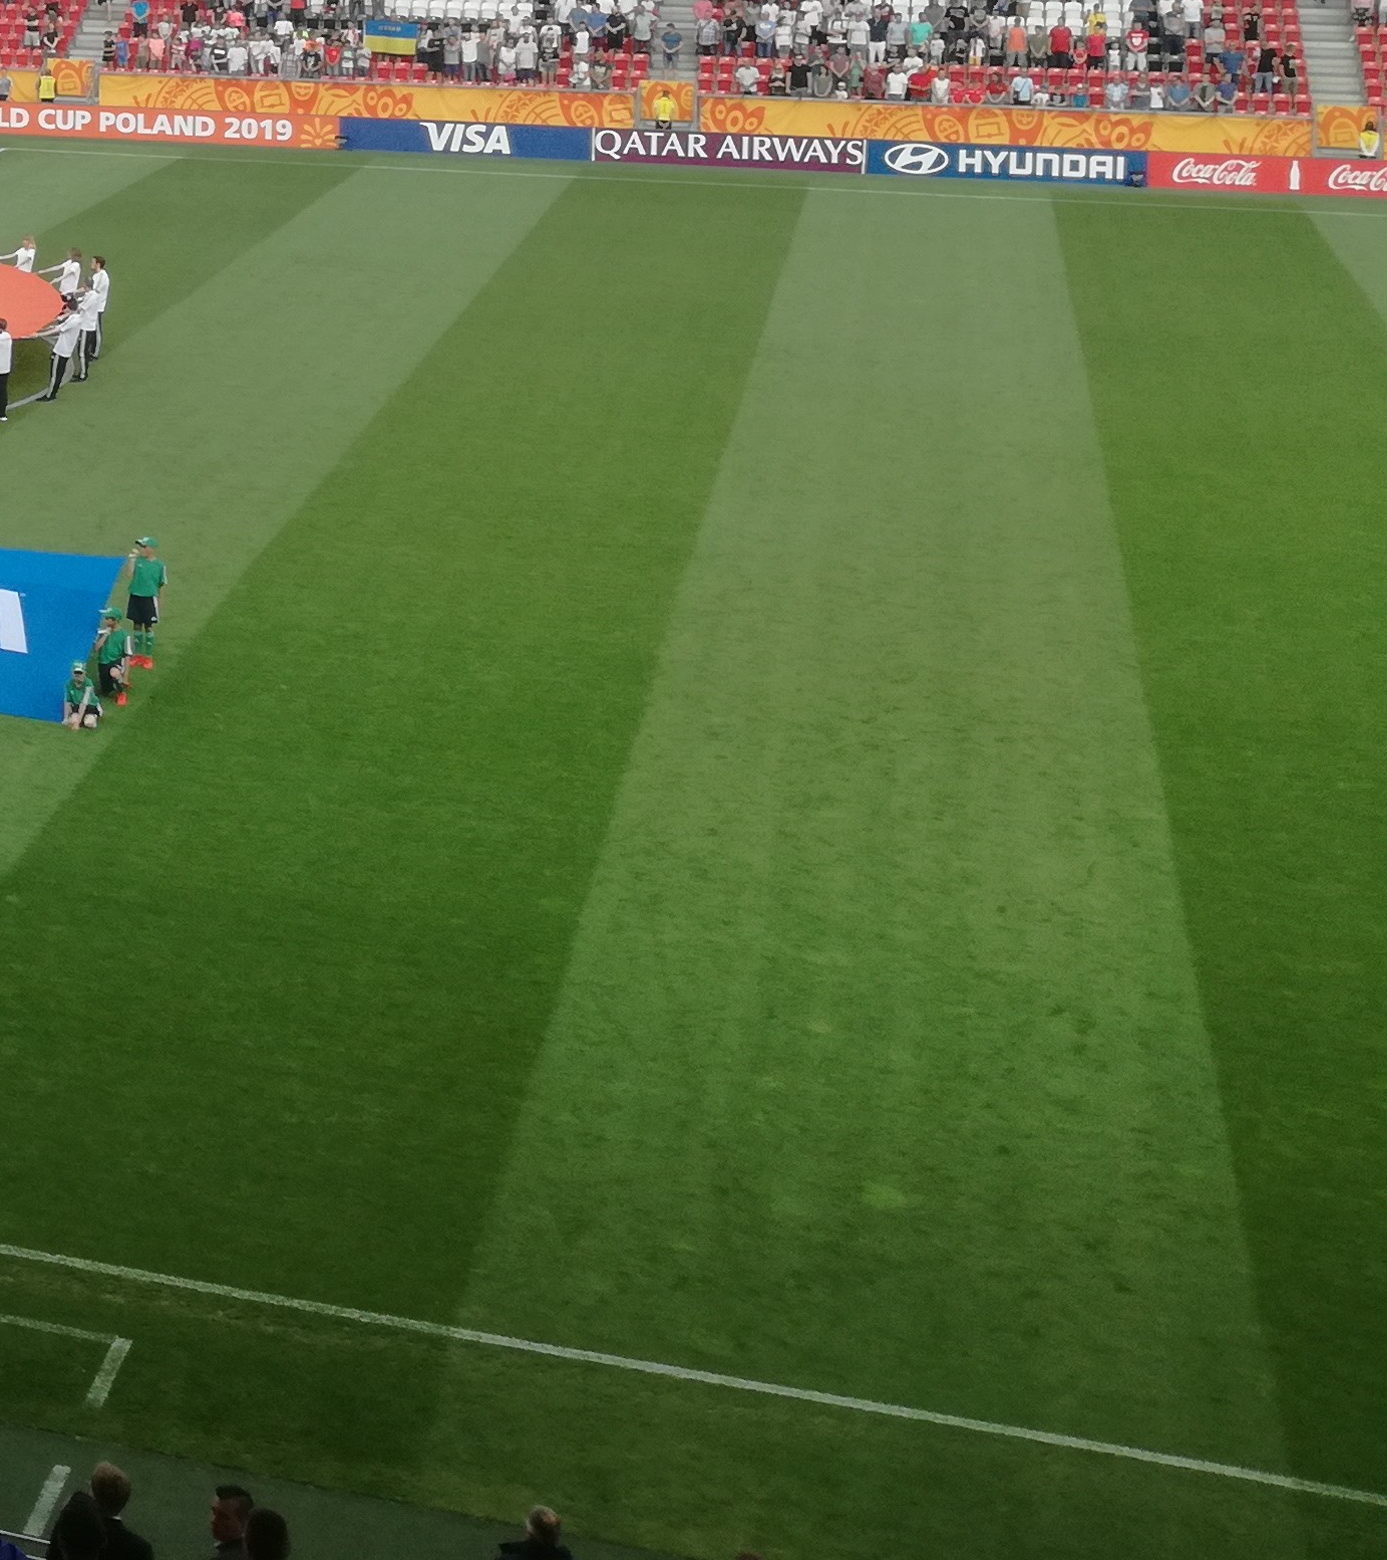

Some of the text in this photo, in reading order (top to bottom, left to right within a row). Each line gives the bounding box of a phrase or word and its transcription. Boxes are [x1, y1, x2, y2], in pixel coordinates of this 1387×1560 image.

[38, 110, 94, 131] CUP
[99, 113, 216, 137] POLAND
[223, 118, 293, 141] 2019
[419, 122, 512, 155] VISA
[595, 129, 864, 166] QATAR AIRWAYS
[958, 149, 1125, 181] HYUNDAI
